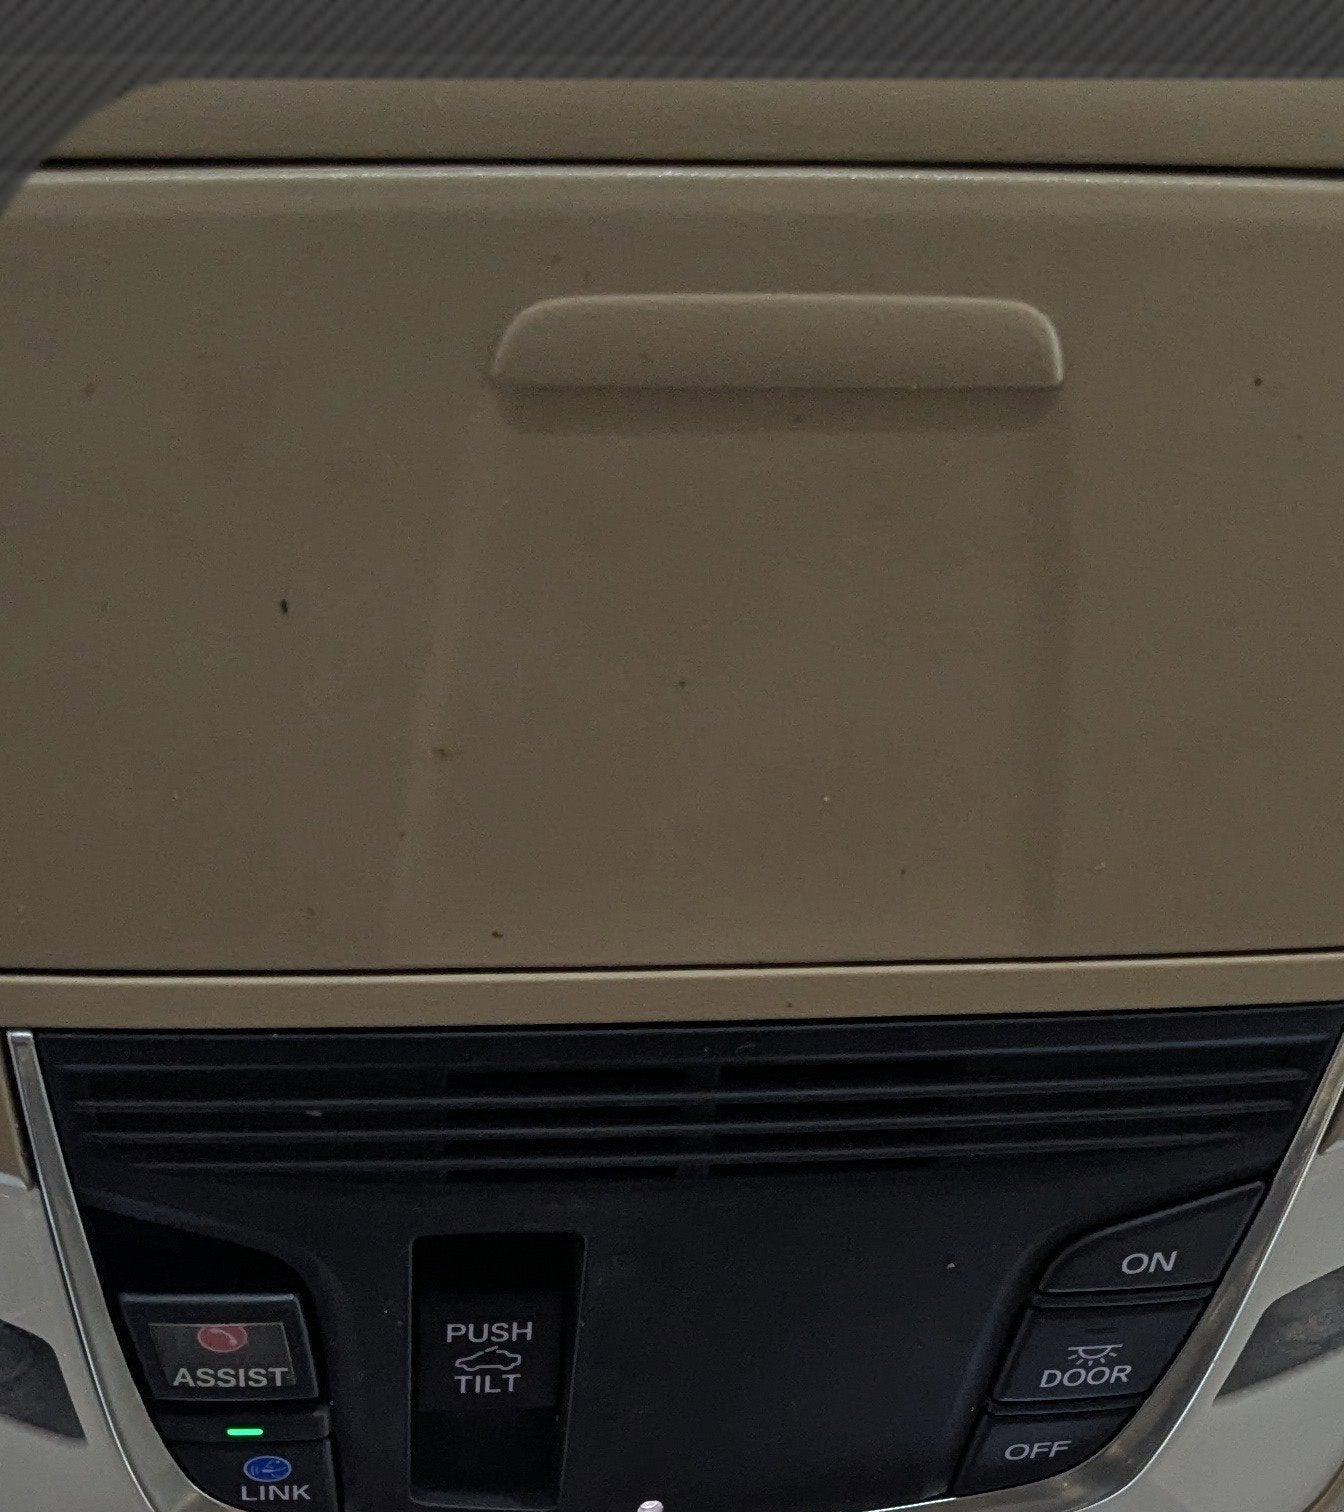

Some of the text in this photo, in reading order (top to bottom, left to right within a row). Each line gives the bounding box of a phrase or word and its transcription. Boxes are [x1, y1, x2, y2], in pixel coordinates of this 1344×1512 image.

[1120, 1250, 1178, 1275] ON
[445, 1321, 533, 1343] PUSH
[172, 1366, 289, 1388] ASSIST
[454, 1373, 522, 1394] TILT
[1039, 1364, 1132, 1389] DOOR
[1004, 1440, 1072, 1461] OFF
[240, 1483, 312, 1502] LINK
